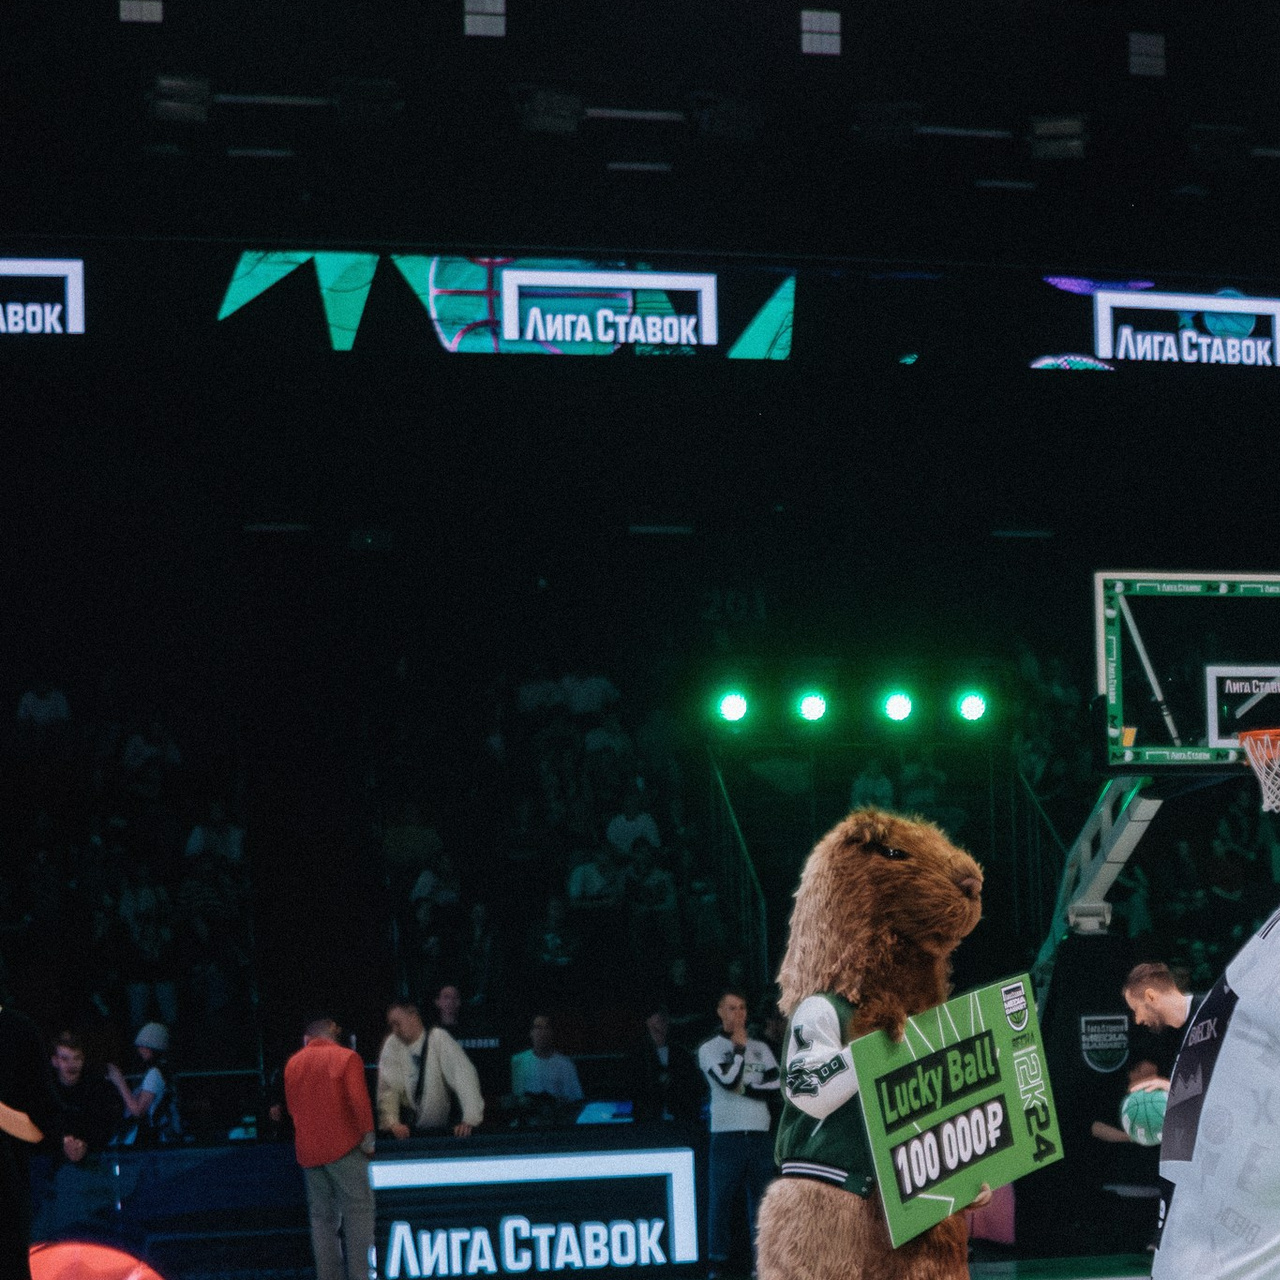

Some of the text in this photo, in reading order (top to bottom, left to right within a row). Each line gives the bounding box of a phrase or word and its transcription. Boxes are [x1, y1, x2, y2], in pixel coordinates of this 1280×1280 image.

[526, 306, 698, 347] Лига Ставок
[1117, 325, 1272, 367] Лига Ставок
[881, 1037, 995, 1124] Lucky Ball
[897, 1131, 941, 1195] 100
[385, 1215, 667, 1280] Лига Ставок
